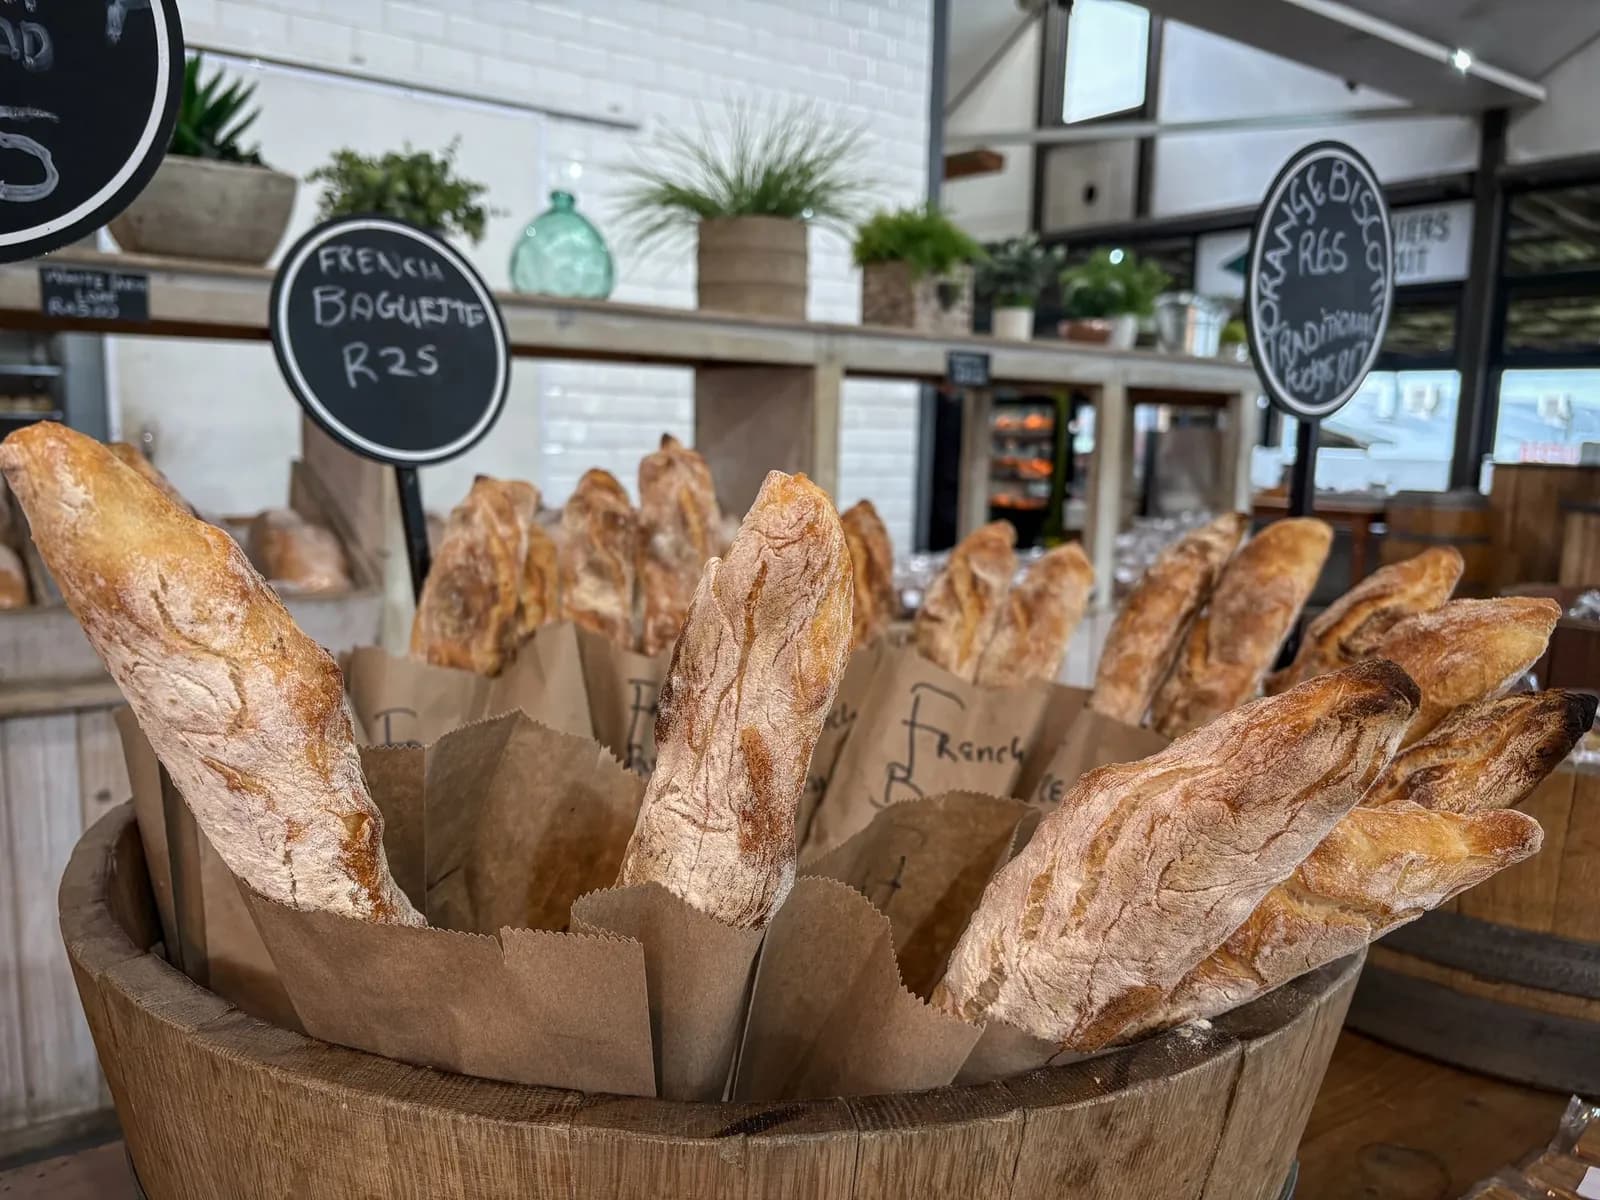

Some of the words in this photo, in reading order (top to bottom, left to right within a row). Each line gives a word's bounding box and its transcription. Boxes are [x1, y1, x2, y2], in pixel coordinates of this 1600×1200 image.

[318, 246, 444, 281] FRENCH
[1259, 165, 1327, 334] ORANGE
[1299, 227, 1348, 276] R65
[313, 285, 486, 328] BAGUETTE
[343, 342, 439, 388] R25
